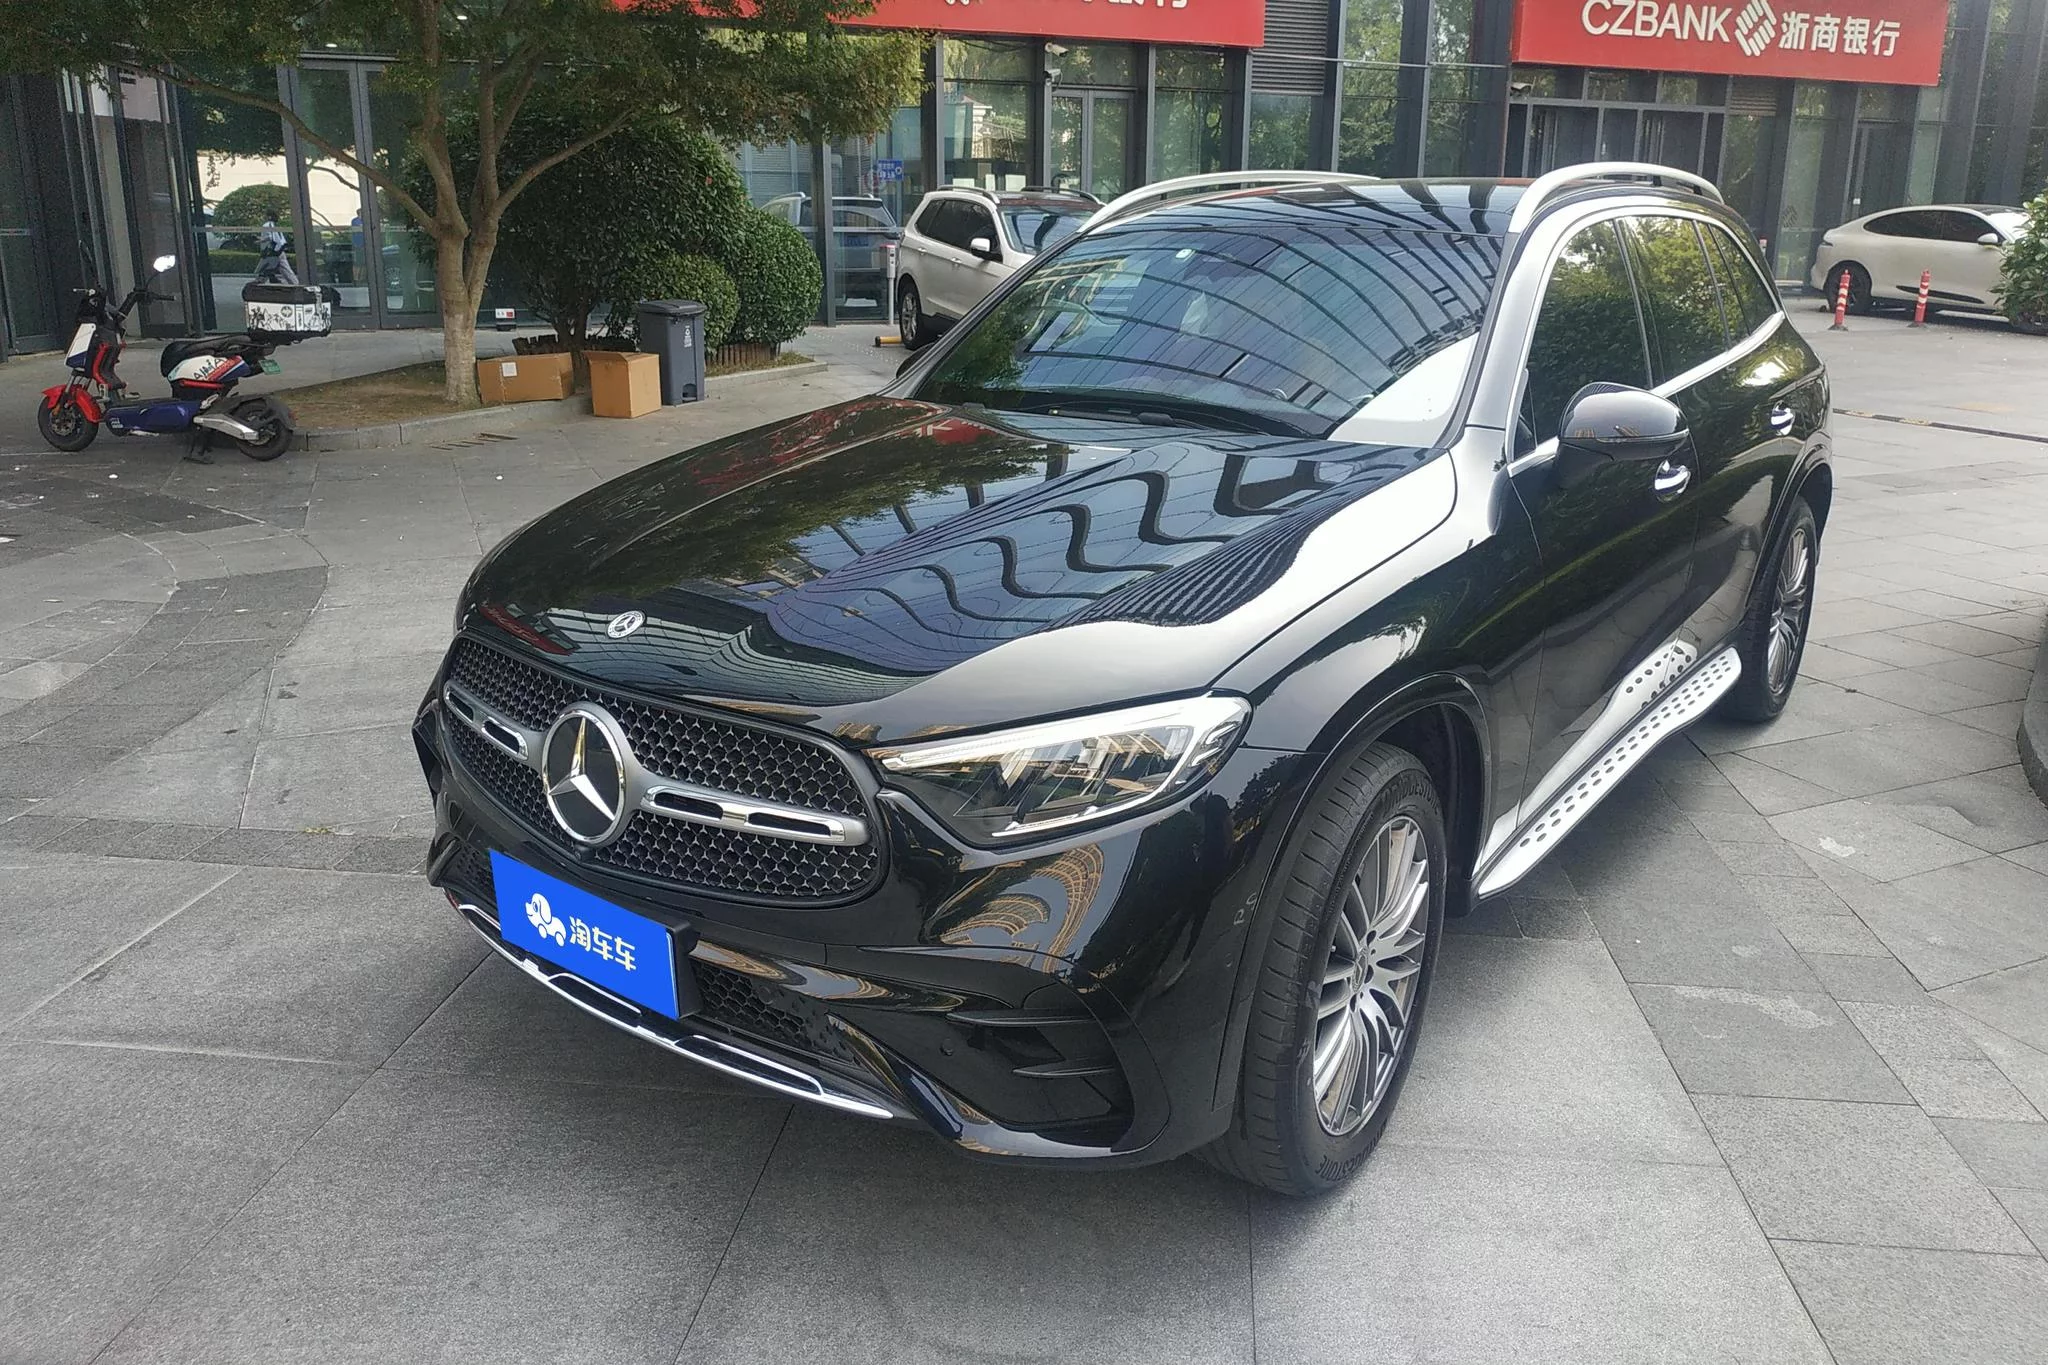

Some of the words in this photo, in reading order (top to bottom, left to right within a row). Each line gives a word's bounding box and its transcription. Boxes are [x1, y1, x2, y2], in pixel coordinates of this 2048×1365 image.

[1581, 0, 1732, 43] CZBANK
[1778, 10, 1900, 56] 浙商银行
